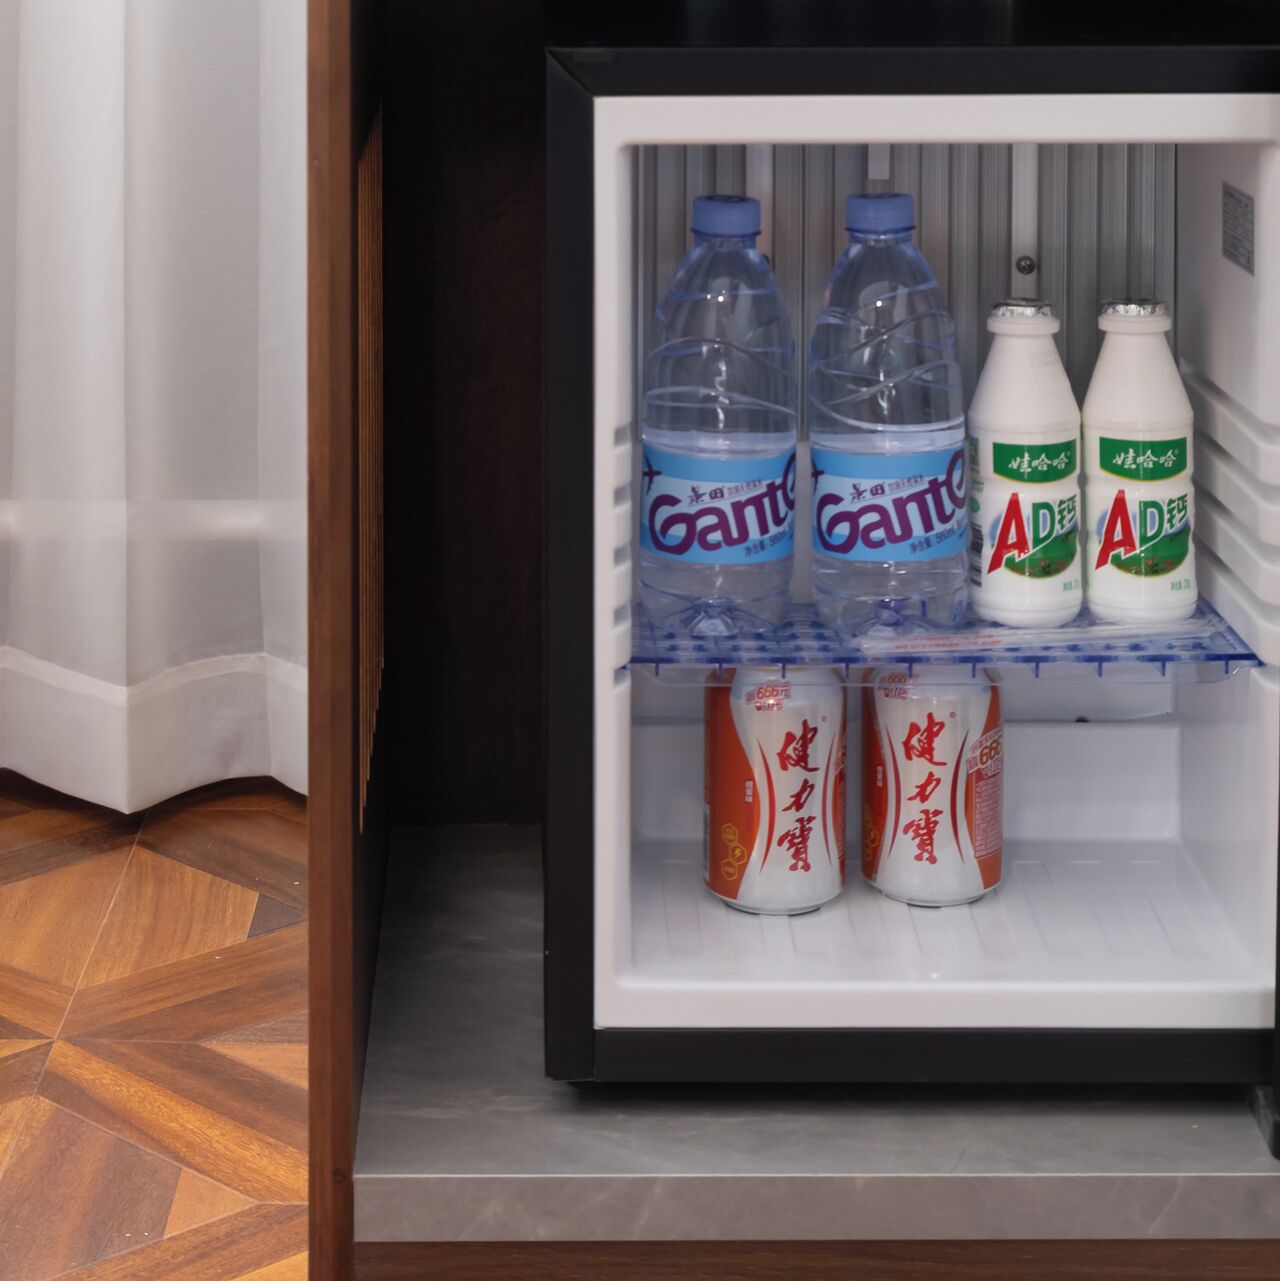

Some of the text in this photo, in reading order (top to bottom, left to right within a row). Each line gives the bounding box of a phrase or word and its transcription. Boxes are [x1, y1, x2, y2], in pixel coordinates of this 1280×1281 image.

[1008, 451, 1069, 472] 娃哈哈
[1112, 447, 1177, 469] 娃哈哈
